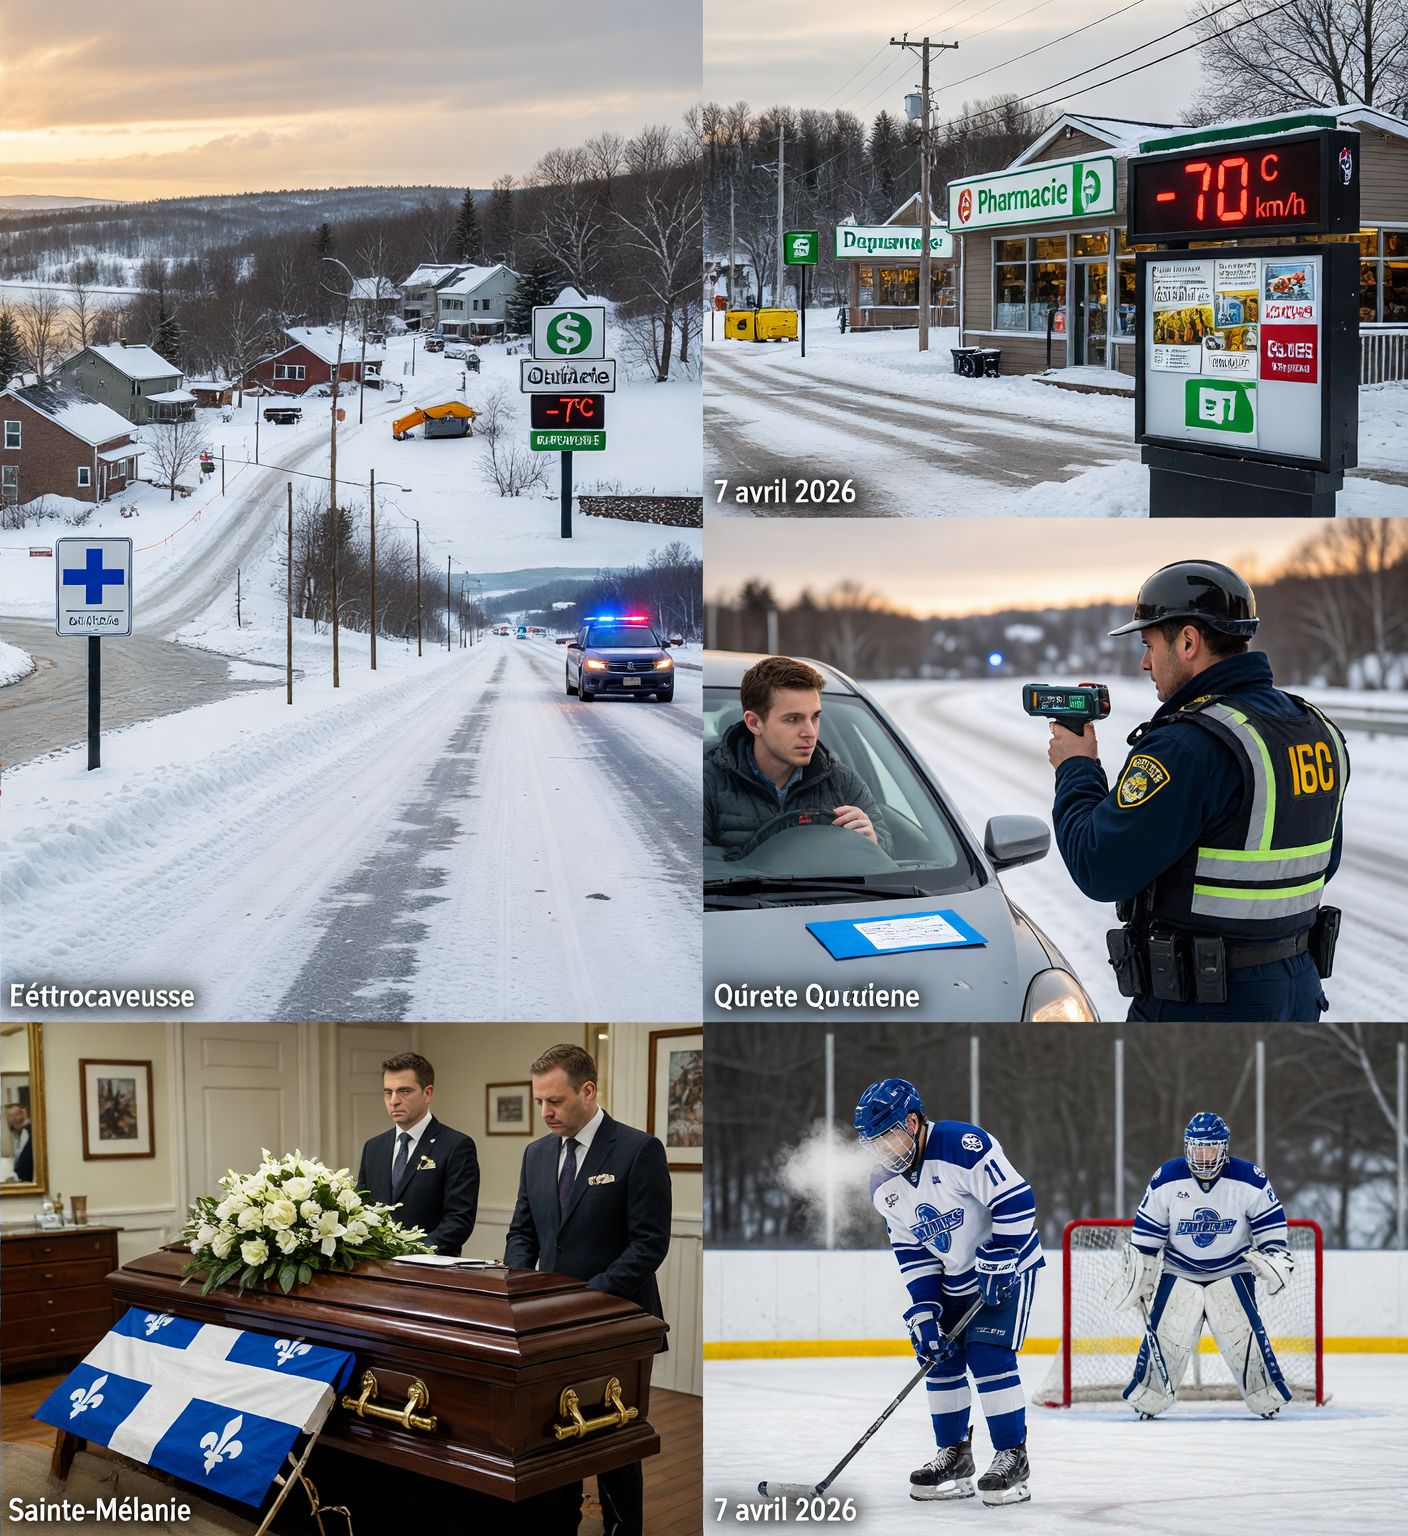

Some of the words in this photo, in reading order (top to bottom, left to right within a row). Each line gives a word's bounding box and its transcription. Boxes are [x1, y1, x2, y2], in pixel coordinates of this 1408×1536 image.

[978, 178, 1068, 214] Pharmacie
[1255, 191, 1306, 218] km/h
[983, 1158, 1007, 1187] 11
